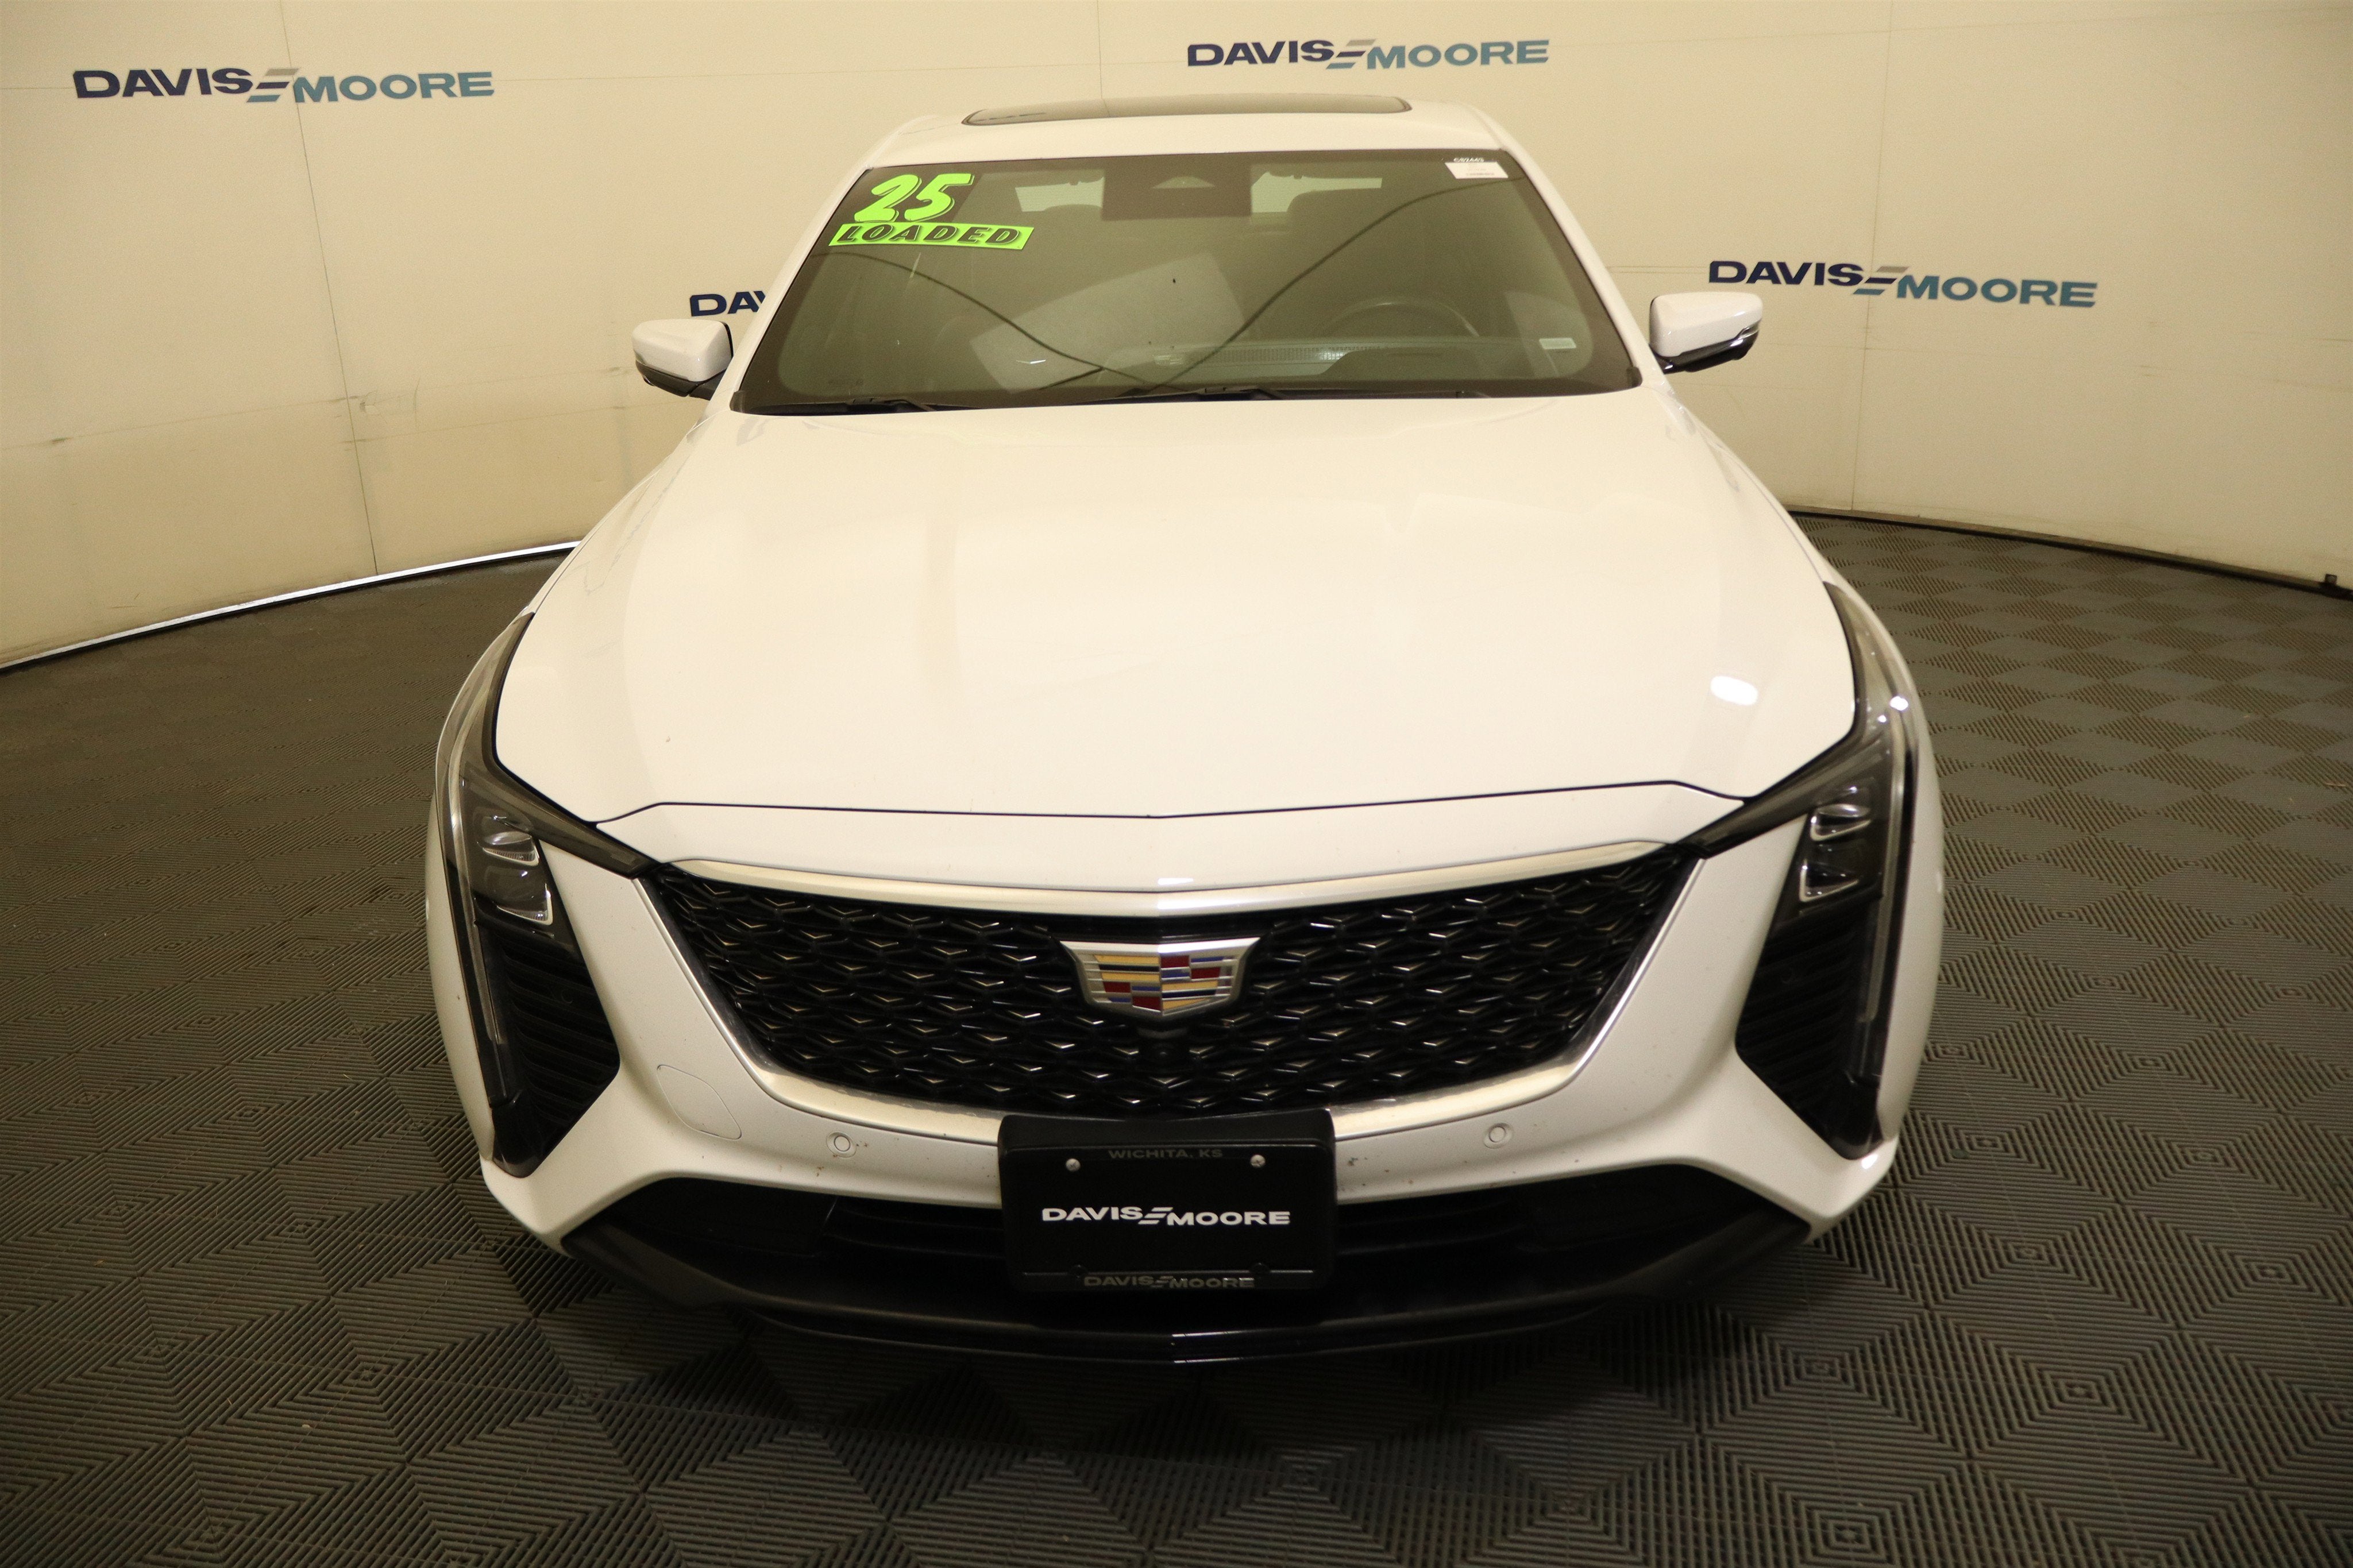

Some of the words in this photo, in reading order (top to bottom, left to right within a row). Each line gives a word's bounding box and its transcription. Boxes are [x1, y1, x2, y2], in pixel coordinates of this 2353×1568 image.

[1187, 40, 1334, 67] DAVIS
[1366, 40, 1549, 69] MOORE
[72, 68, 253, 99] DAVIS
[291, 71, 495, 103] MOORE
[854, 173, 975, 223] 25
[837, 223, 1020, 245] LOADED
[1708, 261, 1864, 286] DAVIS
[1896, 275, 2098, 308] MOORE
[1199, 1148, 1223, 1158] KS
[1042, 1206, 1142, 1222] DAVIS
[1166, 1211, 1291, 1226] MOORE
[1083, 1275, 1155, 1287] DAVIS
[1168, 1277, 1255, 1289] MOORE
